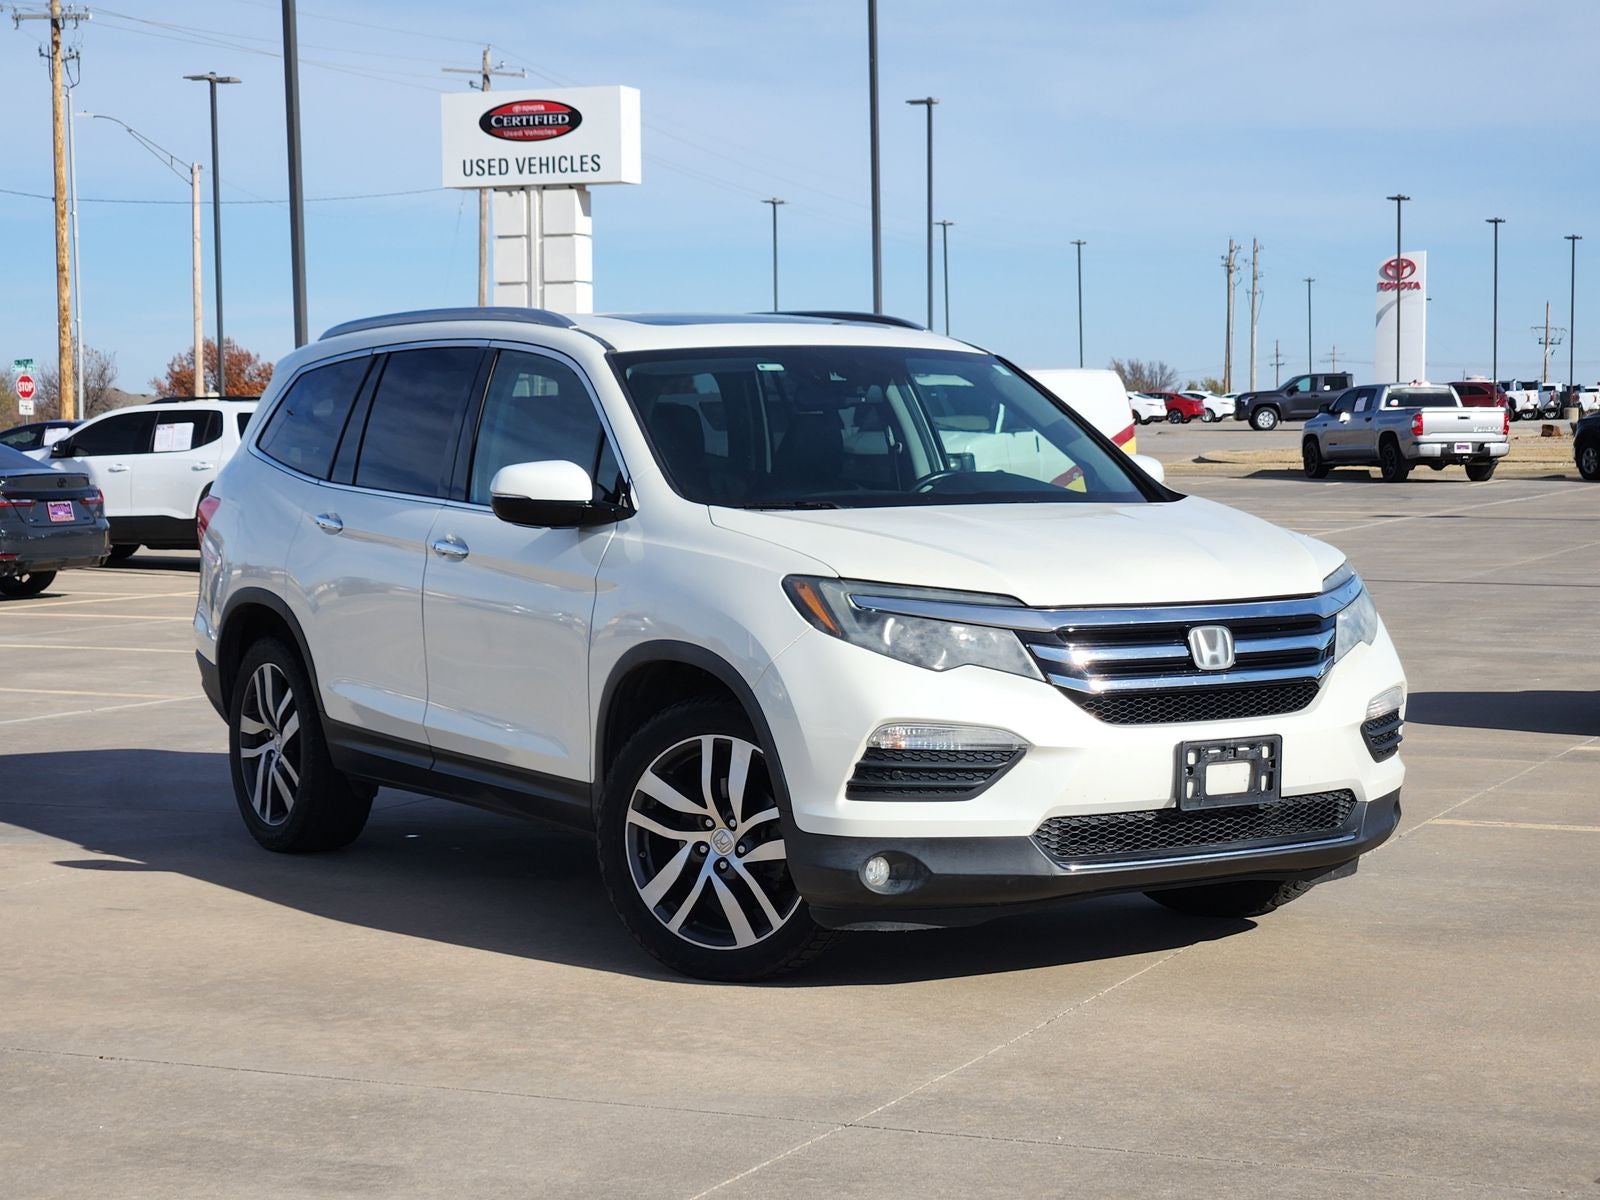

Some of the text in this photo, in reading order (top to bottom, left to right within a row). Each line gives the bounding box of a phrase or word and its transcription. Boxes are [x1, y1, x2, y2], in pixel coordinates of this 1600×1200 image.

[490, 114, 570, 128] CERTIFIED
[523, 129, 557, 137] Vehicles
[462, 154, 601, 177] USED VEHICLES
[18, 381, 34, 392] STOP
